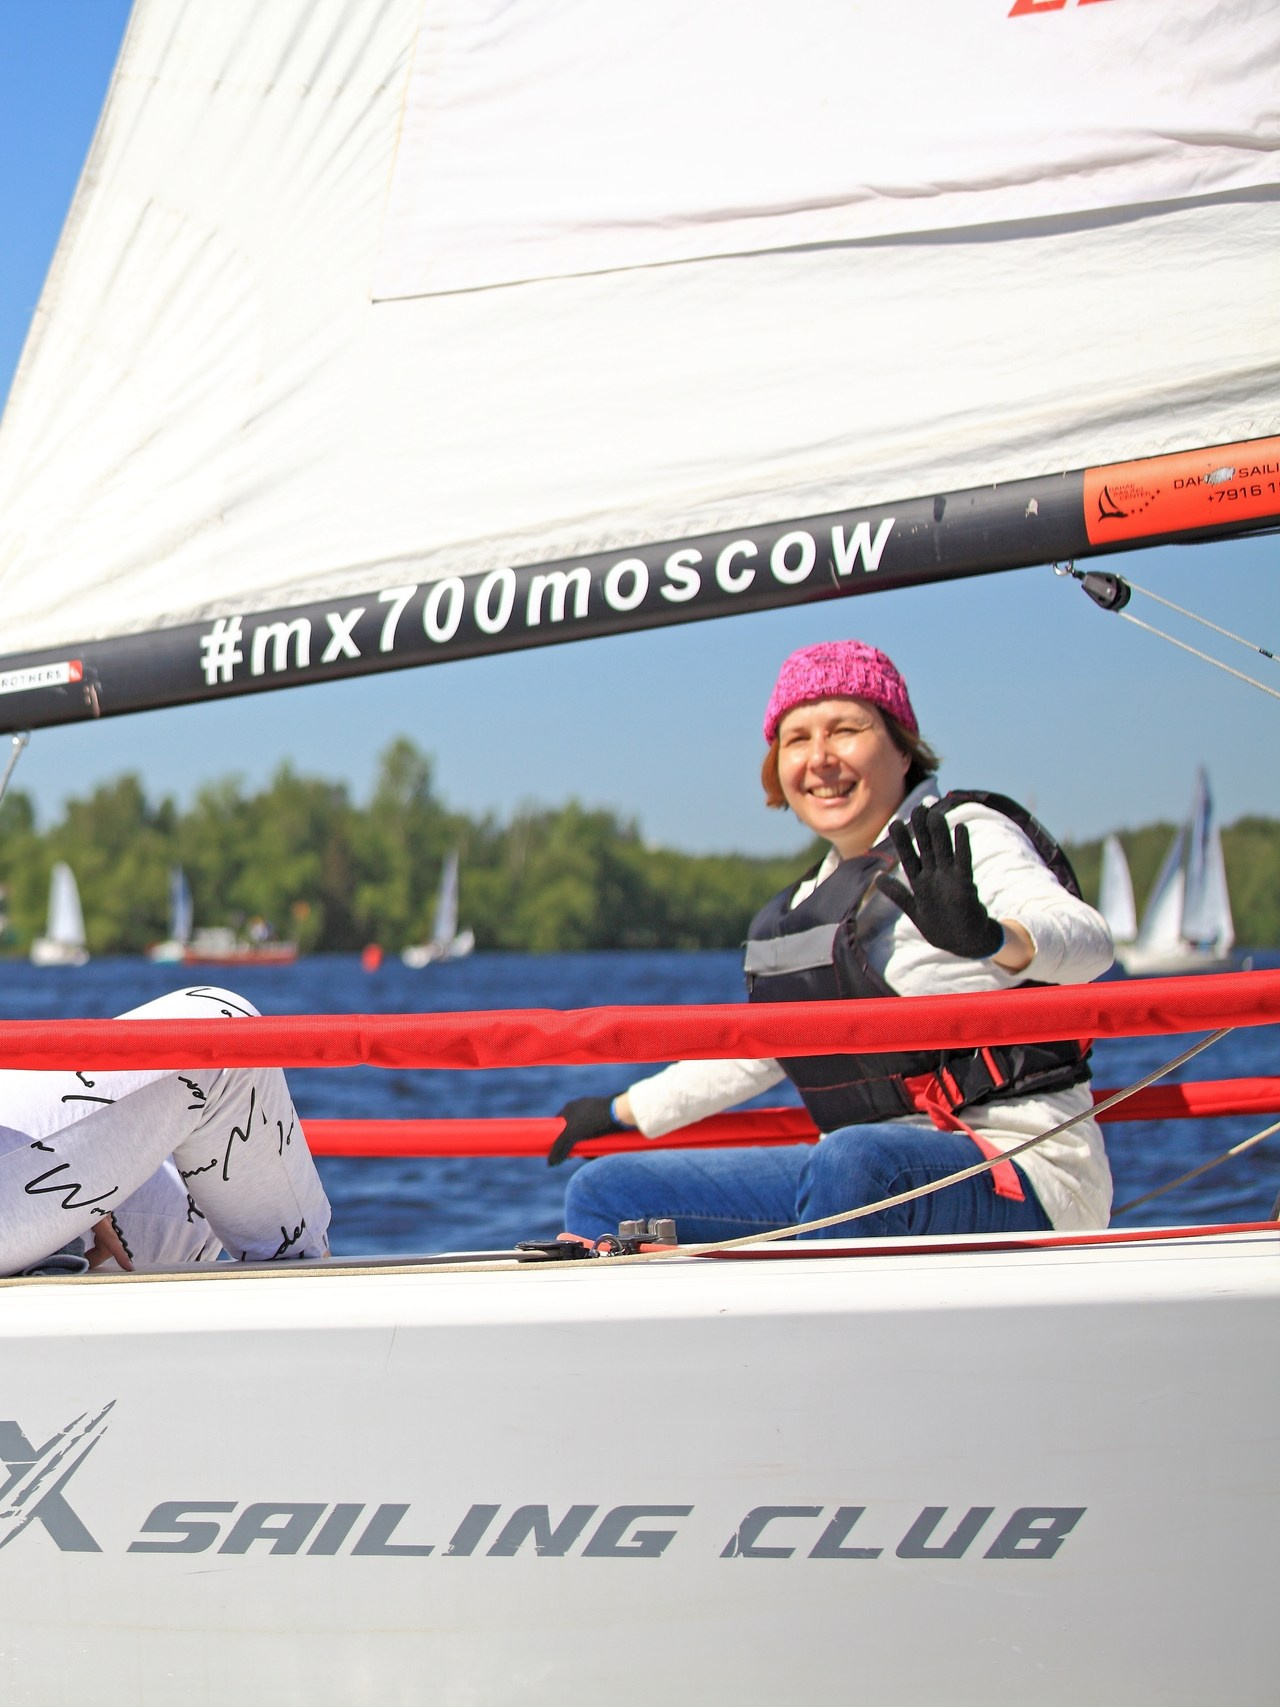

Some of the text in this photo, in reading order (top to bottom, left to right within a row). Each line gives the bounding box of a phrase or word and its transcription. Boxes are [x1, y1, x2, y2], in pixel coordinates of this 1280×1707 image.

[1208, 485, 1262, 502] +7916
[200, 517, 896, 686] #mx700moscow
[127, 1502, 694, 1557] SAILING
[720, 1506, 1087, 1559] CLUB
